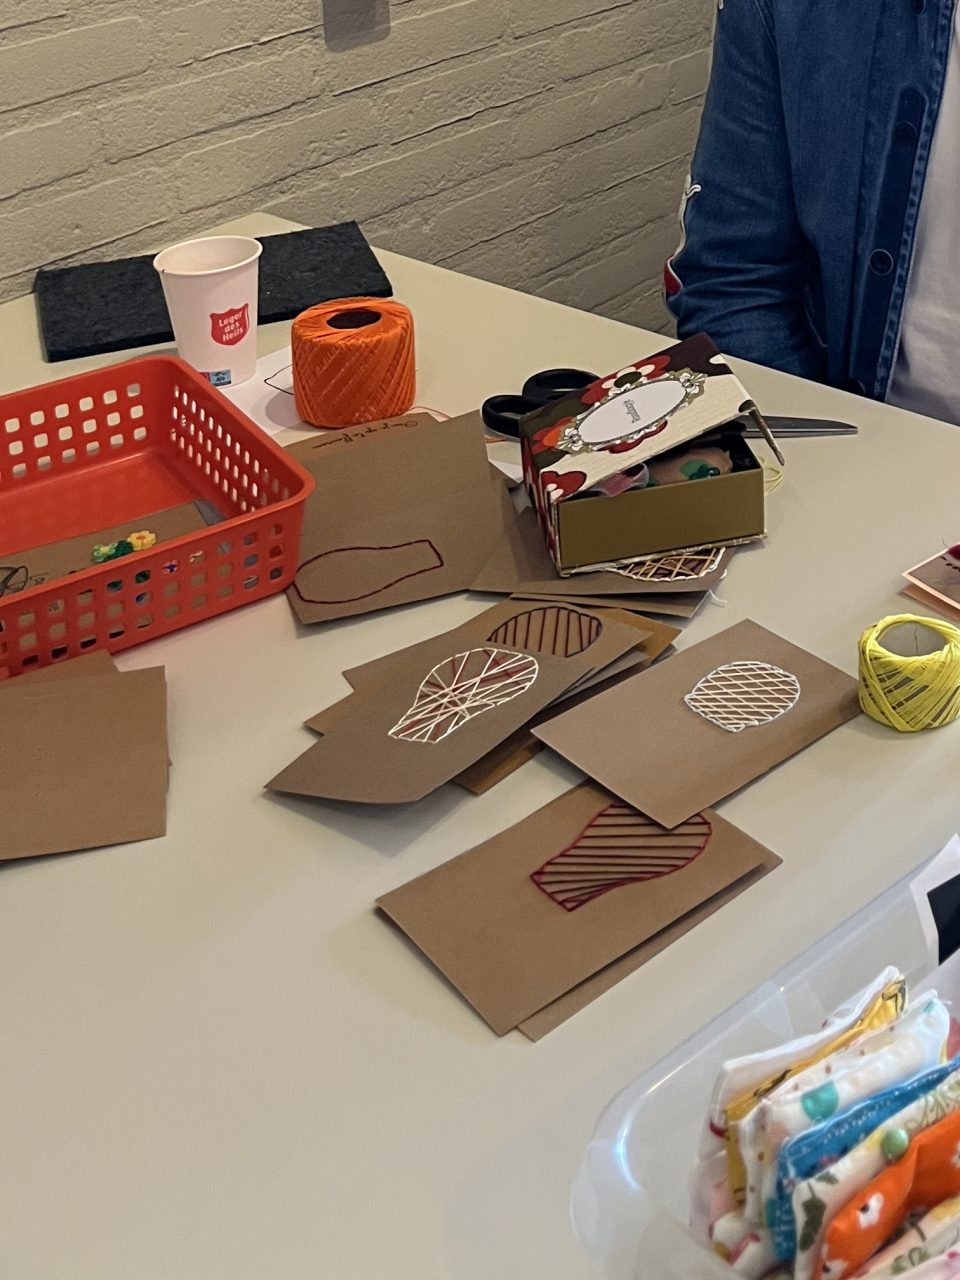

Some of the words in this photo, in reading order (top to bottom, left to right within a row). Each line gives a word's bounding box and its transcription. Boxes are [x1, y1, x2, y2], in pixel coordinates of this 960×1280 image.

[219, 310, 242, 328] Leger
[222, 327, 244, 342] Heils
[224, 321, 240, 333] des
